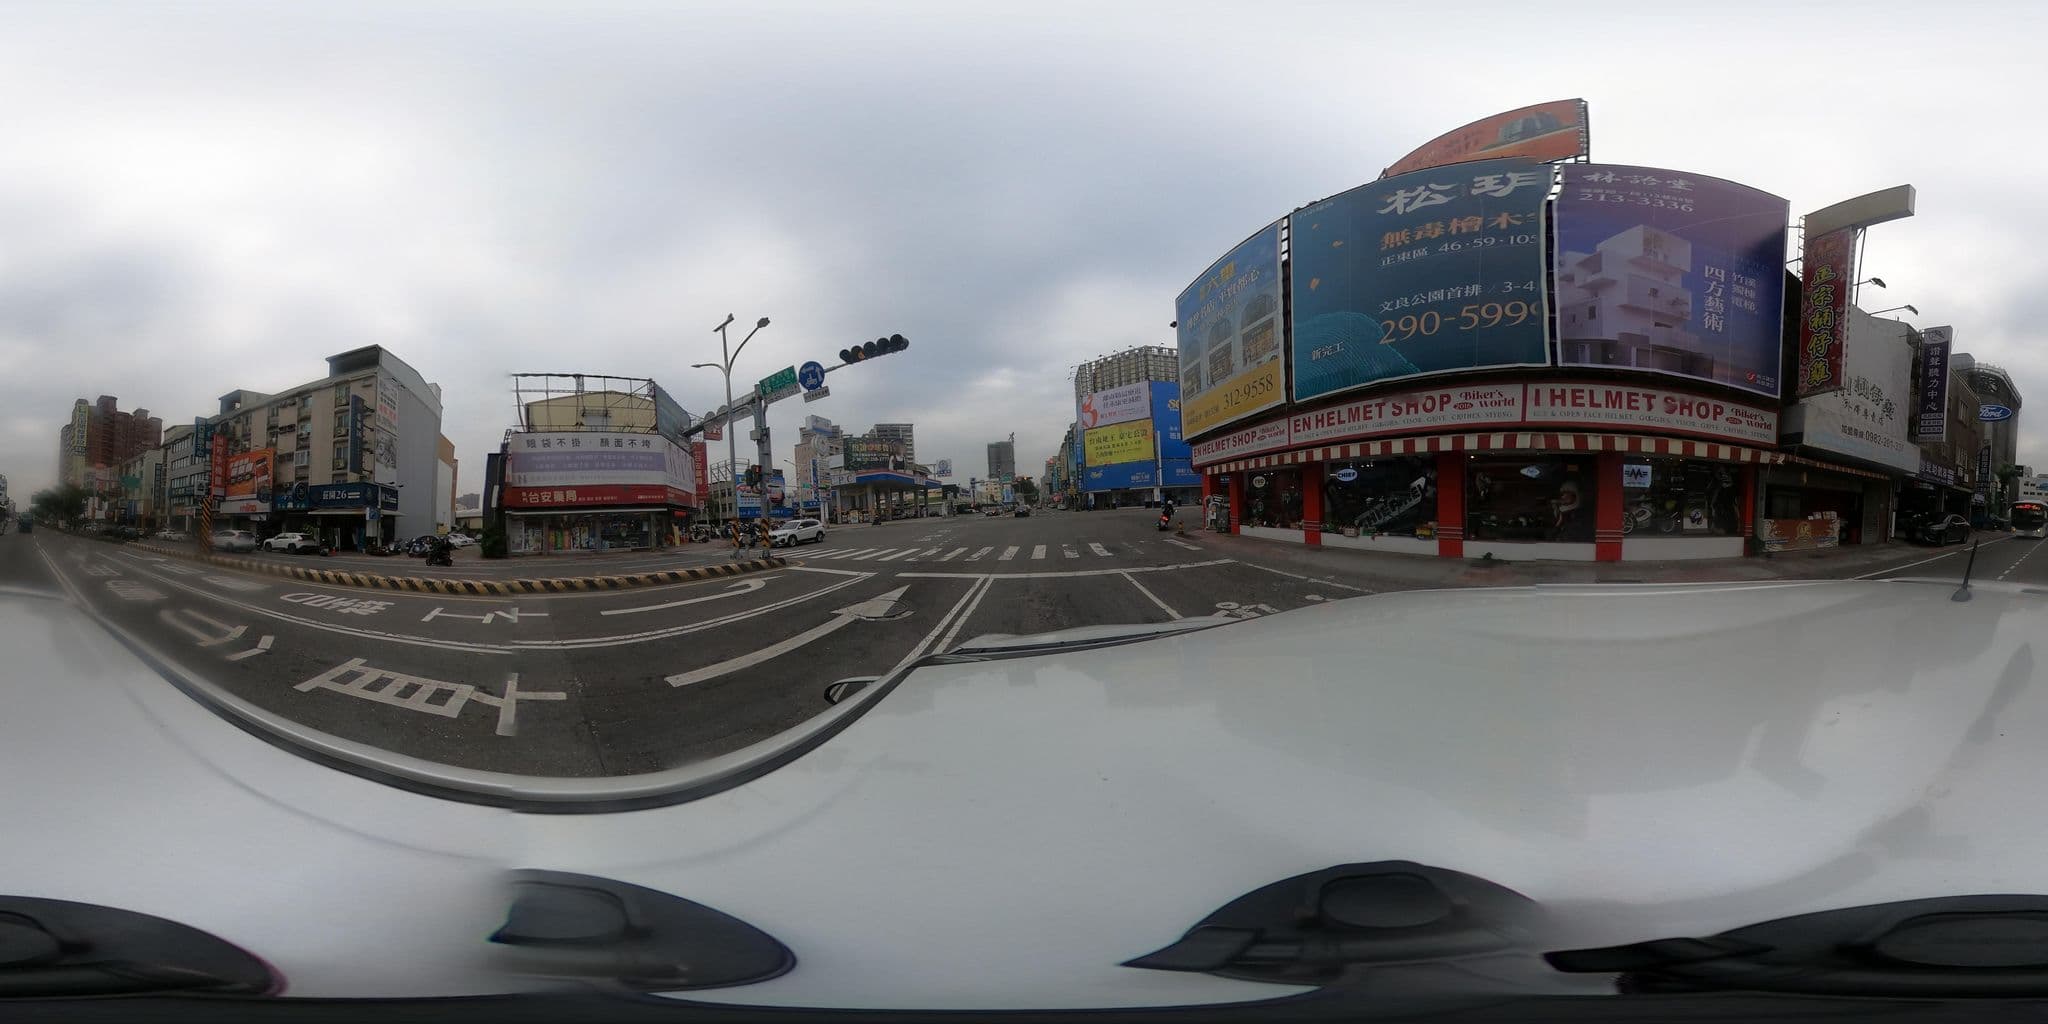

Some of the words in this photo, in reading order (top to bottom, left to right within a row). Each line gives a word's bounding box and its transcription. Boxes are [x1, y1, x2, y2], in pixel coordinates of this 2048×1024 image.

[1579, 193, 1693, 212] 213-3336
[1381, 247, 1430, 266] 正東區
[1379, 284, 1482, 313] 文良公園首排
[1704, 265, 1725, 332] 四方藝術
[1807, 264, 1836, 387] 正宗桶仔雞
[1223, 373, 1274, 409] 312-9558
[1459, 389, 1504, 401] Biker's
[1479, 398, 1515, 407] World
[1549, 388, 1656, 411] HELMET
[1663, 396, 1725, 421] SHOP
[1293, 416, 1311, 433] EN
[1315, 401, 1386, 429] HELMET
[1391, 393, 1452, 417] SHOP
[1193, 446, 1202, 458] EN
[1202, 438, 1231, 455] HELMET
[1232, 430, 1257, 447] SHOP
[528, 489, 577, 504] 台安藥局
